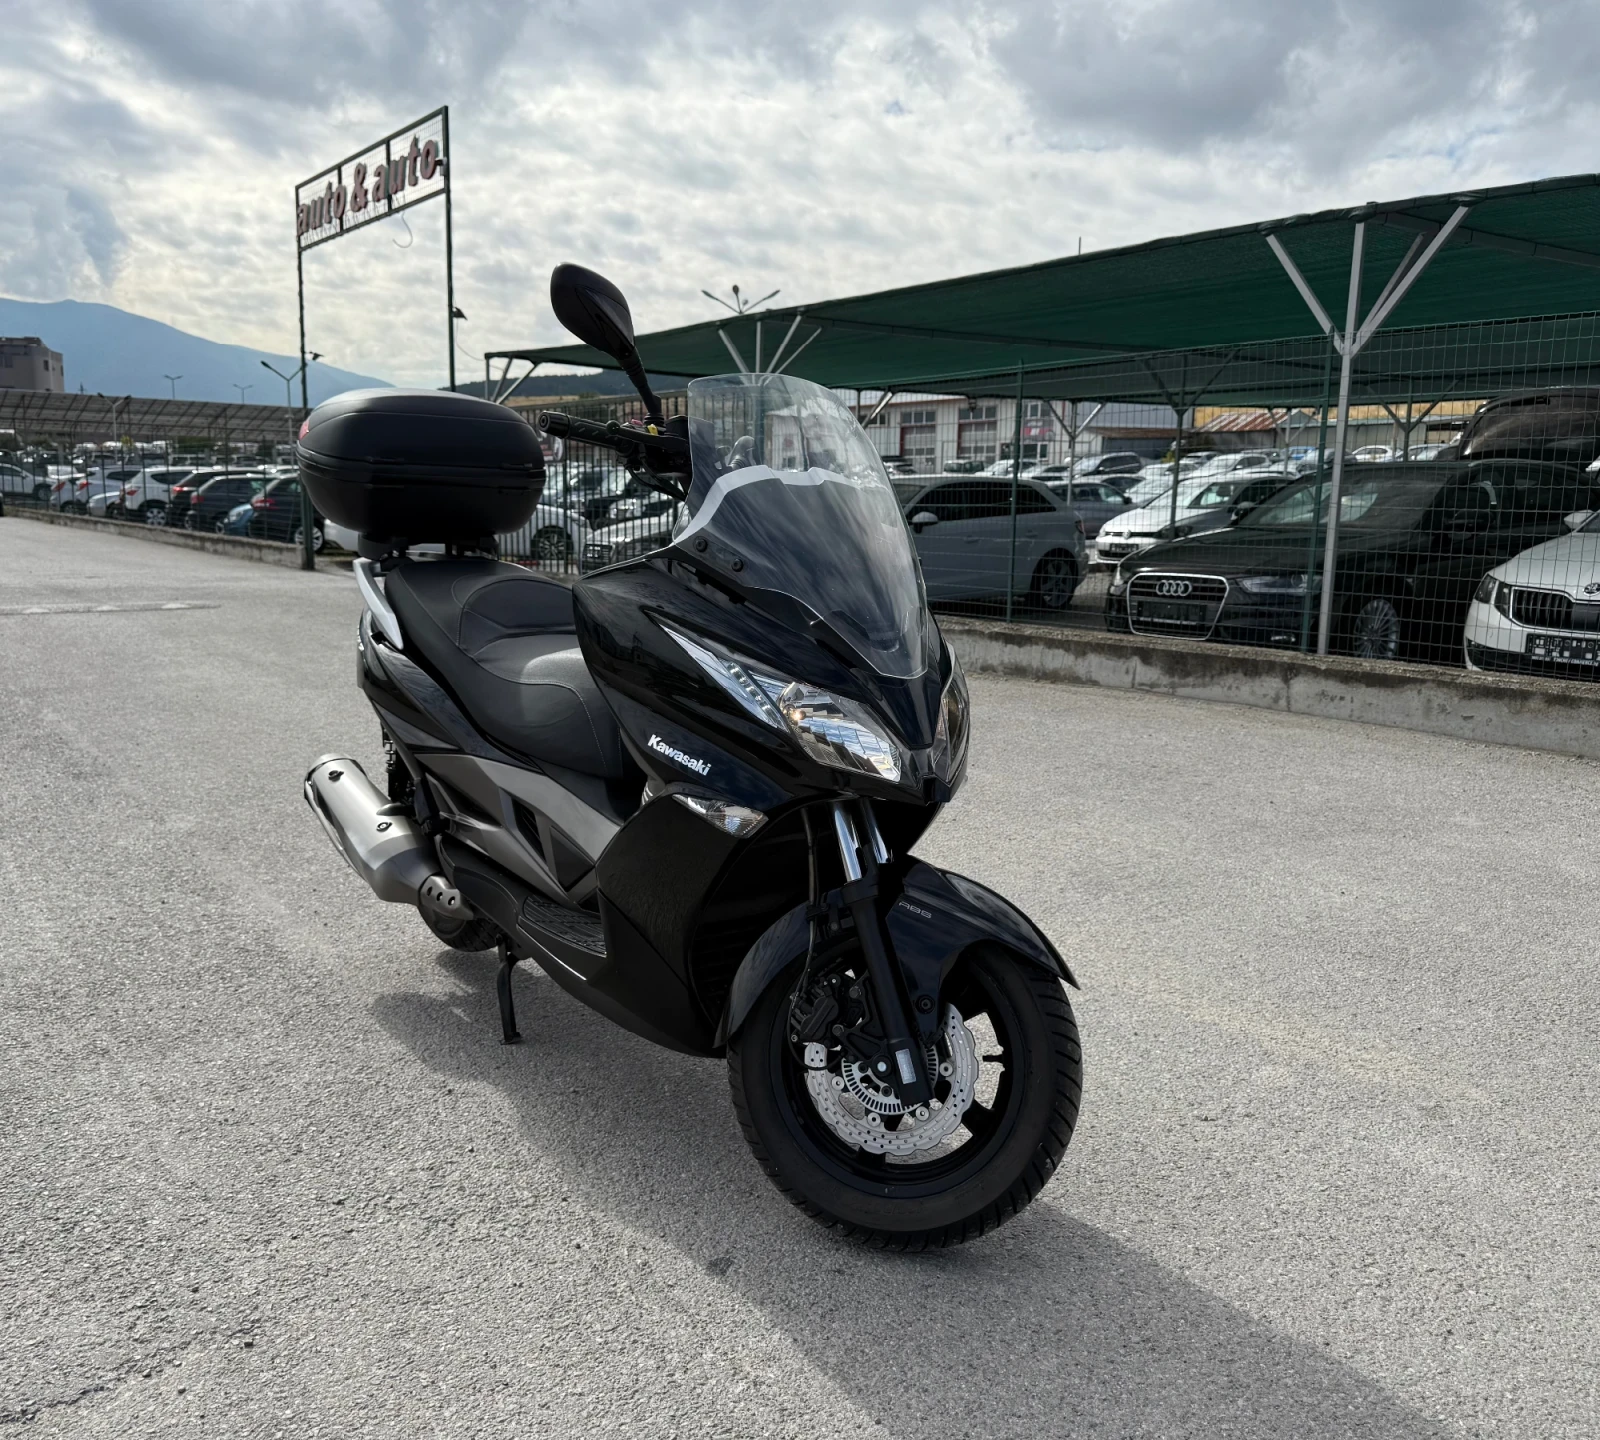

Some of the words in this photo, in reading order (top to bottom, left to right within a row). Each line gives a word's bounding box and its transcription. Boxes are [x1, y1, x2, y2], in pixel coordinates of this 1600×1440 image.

[297, 181, 347, 236] auto
[350, 163, 369, 213] &
[372, 134, 438, 202] auto
[647, 734, 712, 776] Kawasaki
[899, 901, 932, 919] ABS
